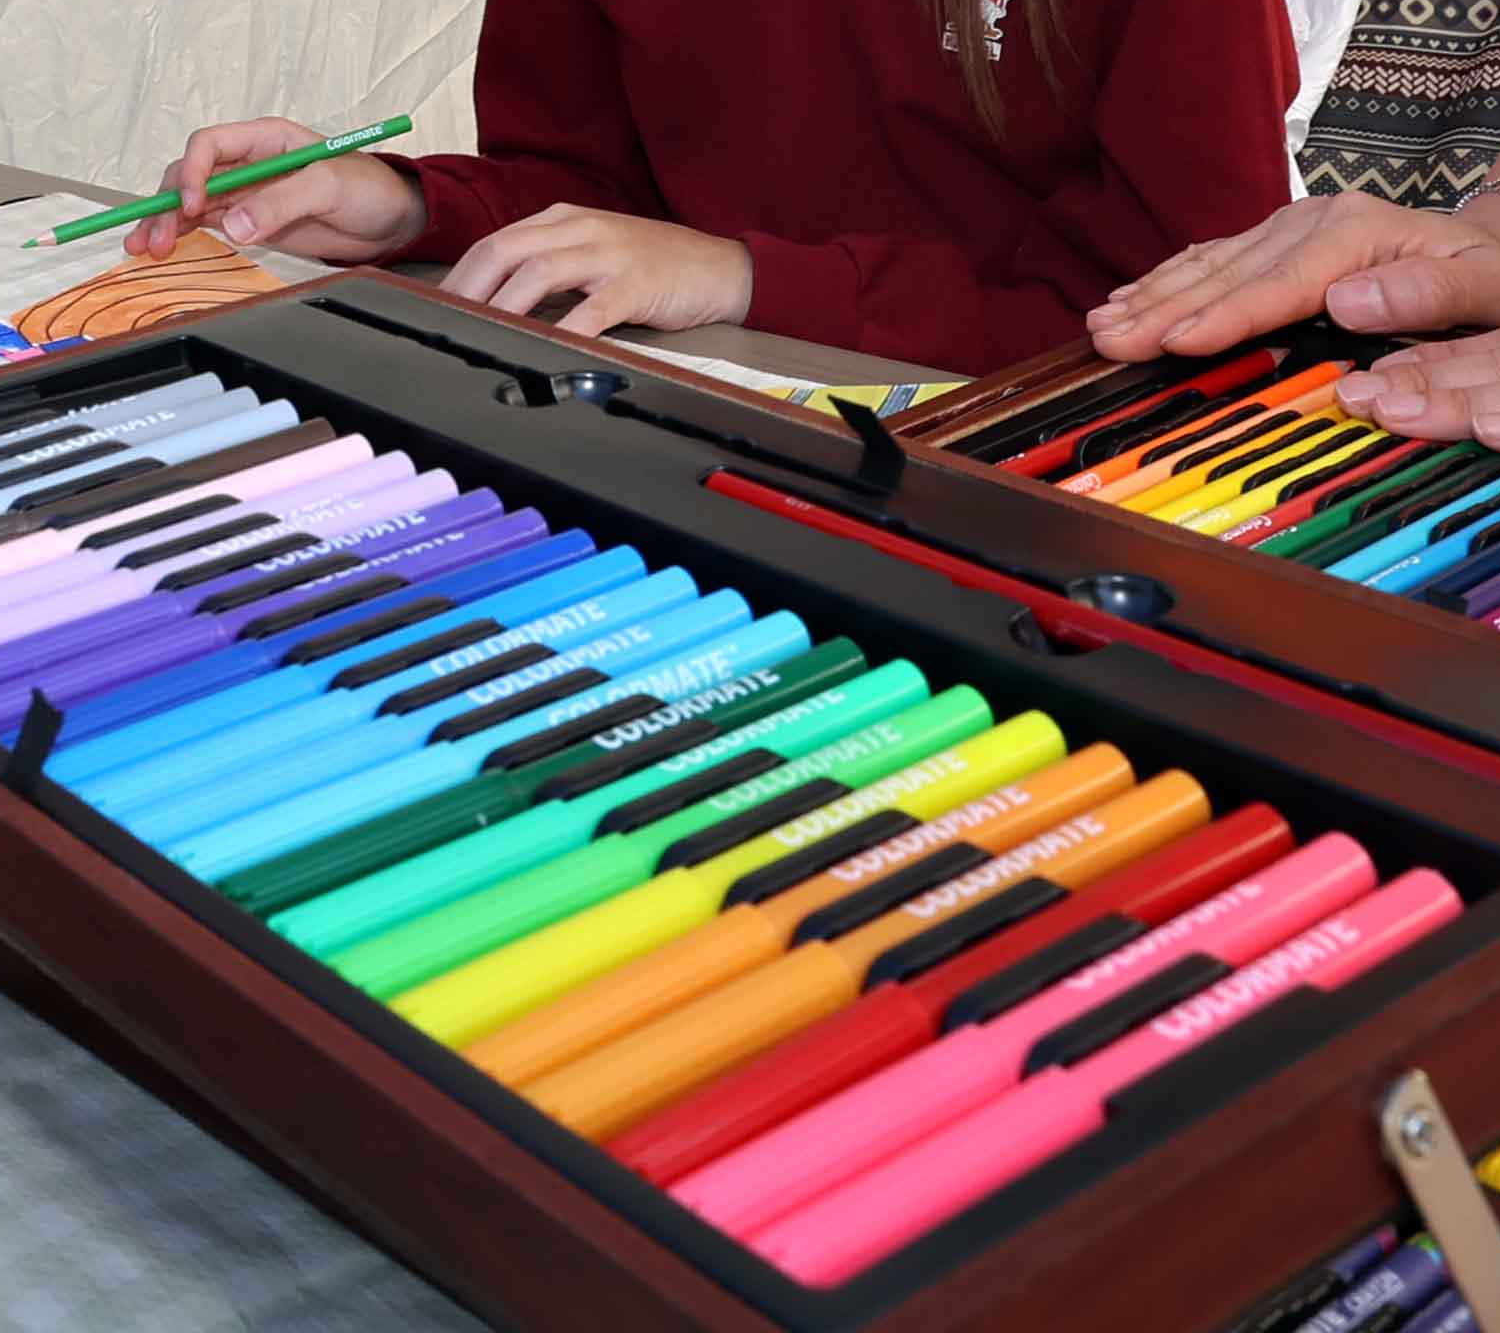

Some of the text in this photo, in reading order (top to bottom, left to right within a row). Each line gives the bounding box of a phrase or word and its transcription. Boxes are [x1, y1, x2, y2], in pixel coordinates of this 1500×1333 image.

[325, 121, 385, 151] Colormate
[429, 598, 608, 677] COLORMATE
[466, 624, 653, 704] COLORMATE
[592, 667, 782, 751] COLORMATE
[708, 721, 904, 812] COLORMATE
[771, 750, 970, 848] COLORMATE
[828, 785, 1033, 882] COLORMATE
[902, 815, 1106, 919] COLORMATE
[1151, 918, 1362, 1041] COLORMATE
